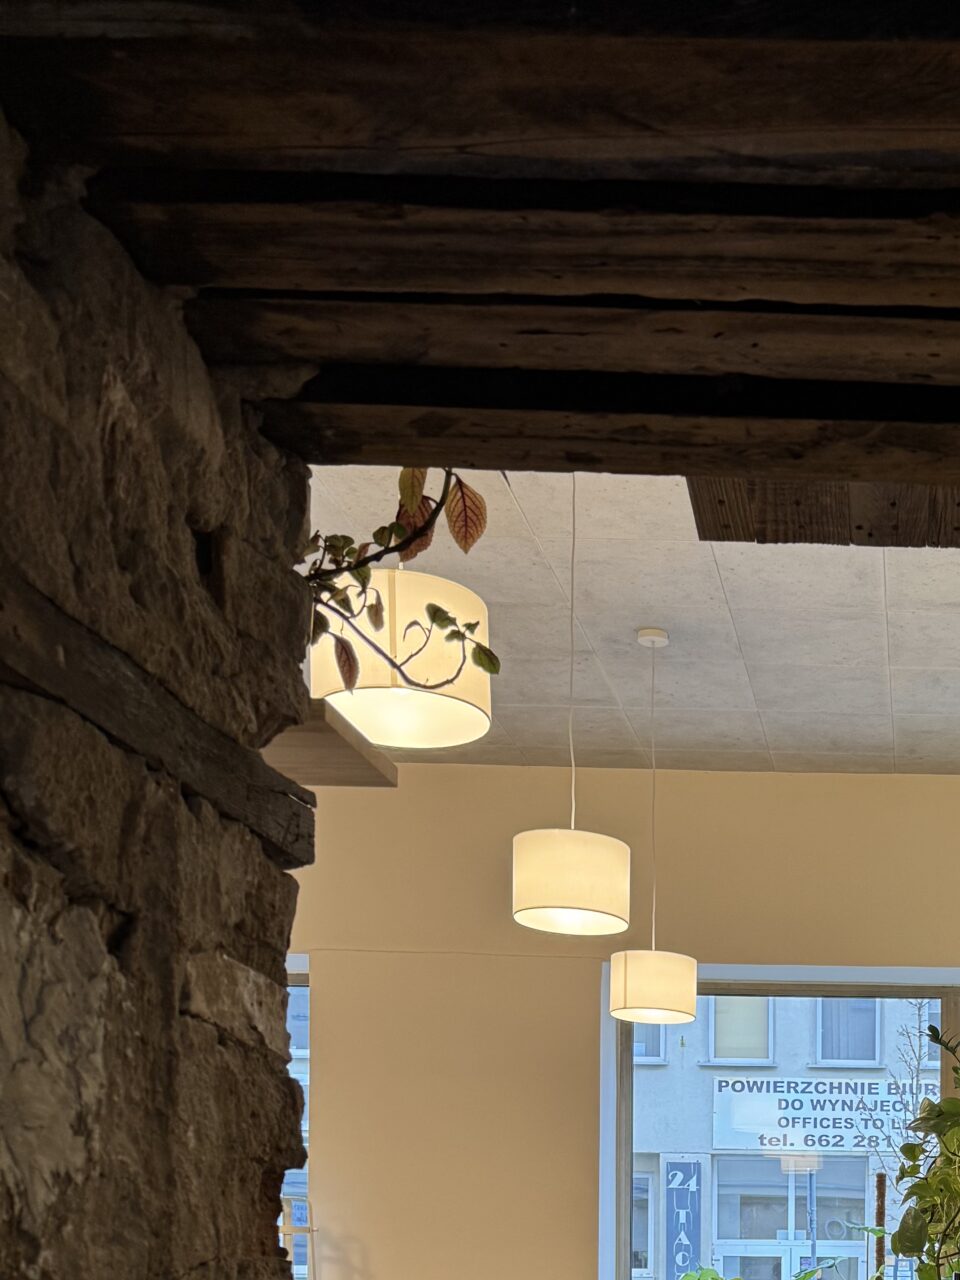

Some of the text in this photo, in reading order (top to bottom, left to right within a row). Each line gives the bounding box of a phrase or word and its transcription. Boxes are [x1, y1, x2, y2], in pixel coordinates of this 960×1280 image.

[717, 1080, 938, 1096] POWIERZCHNIE BIUR
[778, 1098, 804, 1111] DO
[777, 1116, 855, 1129] OFFICES
[861, 1118, 885, 1130] TO
[758, 1133, 795, 1147] tel.
[803, 1134, 845, 1147] 662
[853, 1135, 892, 1148] 281
[665, 1170, 700, 1192] 24
